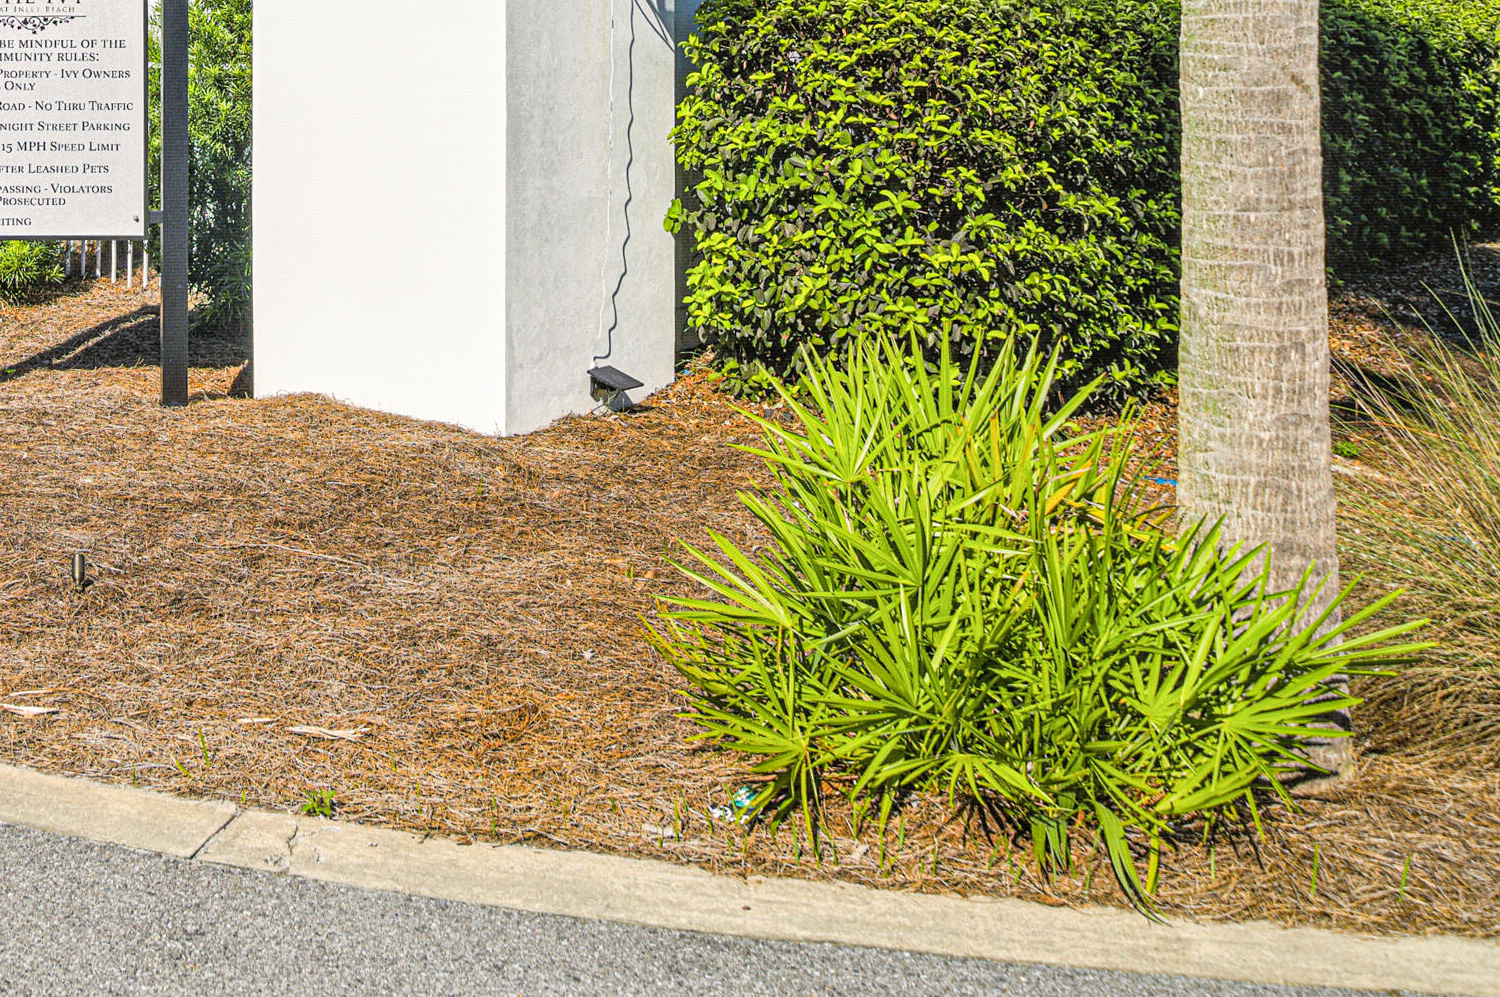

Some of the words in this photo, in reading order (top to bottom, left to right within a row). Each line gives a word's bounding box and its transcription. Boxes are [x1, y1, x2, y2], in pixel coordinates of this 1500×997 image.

[0, 39, 15, 49] BE
[18, 39, 77, 49] MINDFUL
[80, 39, 97, 49] OF
[100, 39, 127, 49] THE
[57, 52, 100, 62] RULES:
[60, 68, 79, 79] IVY
[81, 68, 131, 79] OWNERS
[4, 80, 36, 91] ONLY
[35, 100, 53, 112] NO
[54, 100, 86, 111] THRU
[88, 100, 134, 111] TRAFFIC
[37, 121, 78, 132] STREET
[81, 120, 131, 131] PARKING
[1, 143, 13, 154] 15
[16, 141, 46, 152] MPH
[49, 141, 86, 152] SPEED
[89, 141, 121, 152] LIMIT
[28, 163, 79, 174] LEASHED
[82, 163, 110, 174] PETS
[50, 183, 113, 194] VIOLATORS
